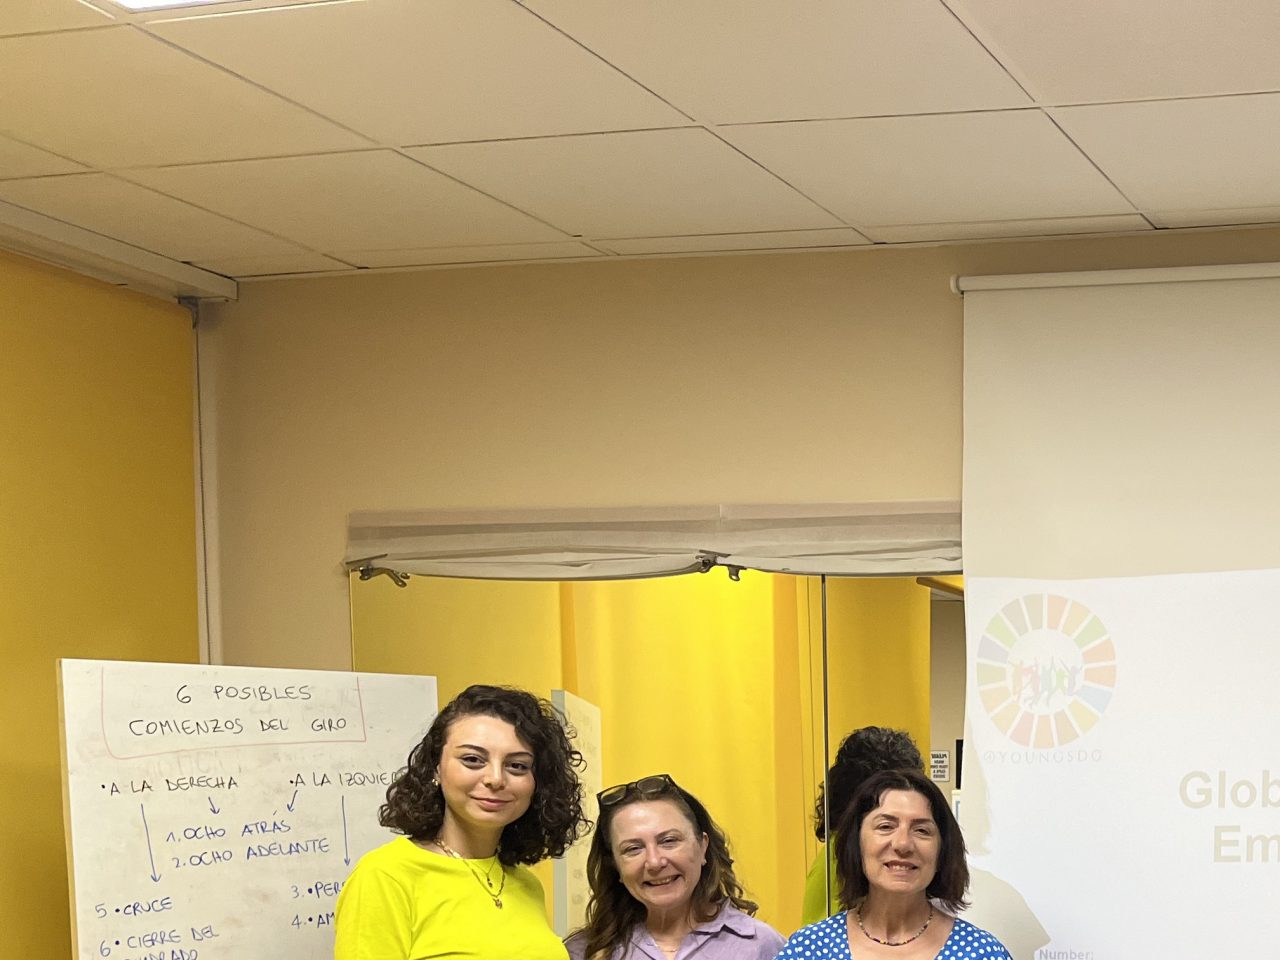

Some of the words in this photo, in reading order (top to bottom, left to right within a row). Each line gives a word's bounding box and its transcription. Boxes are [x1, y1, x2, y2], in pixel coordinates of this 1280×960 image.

[176, 685, 192, 704] 6
[214, 684, 312, 701] POSIBLES
[129, 719, 244, 736] COMIENZOS
[260, 718, 288, 732] DEL
[311, 717, 347, 732] GIRO
[131, 780, 152, 793] LA
[166, 776, 238, 791] DERECHA
[312, 772, 331, 786] LA
[246, 838, 330, 860] ADELANTE
[123, 897, 173, 917] CRUCE
[99, 939, 111, 957] 6
[127, 929, 181, 950] CIERRE
[191, 925, 220, 941] DEL
[1039, 949, 1094, 960] Number:
